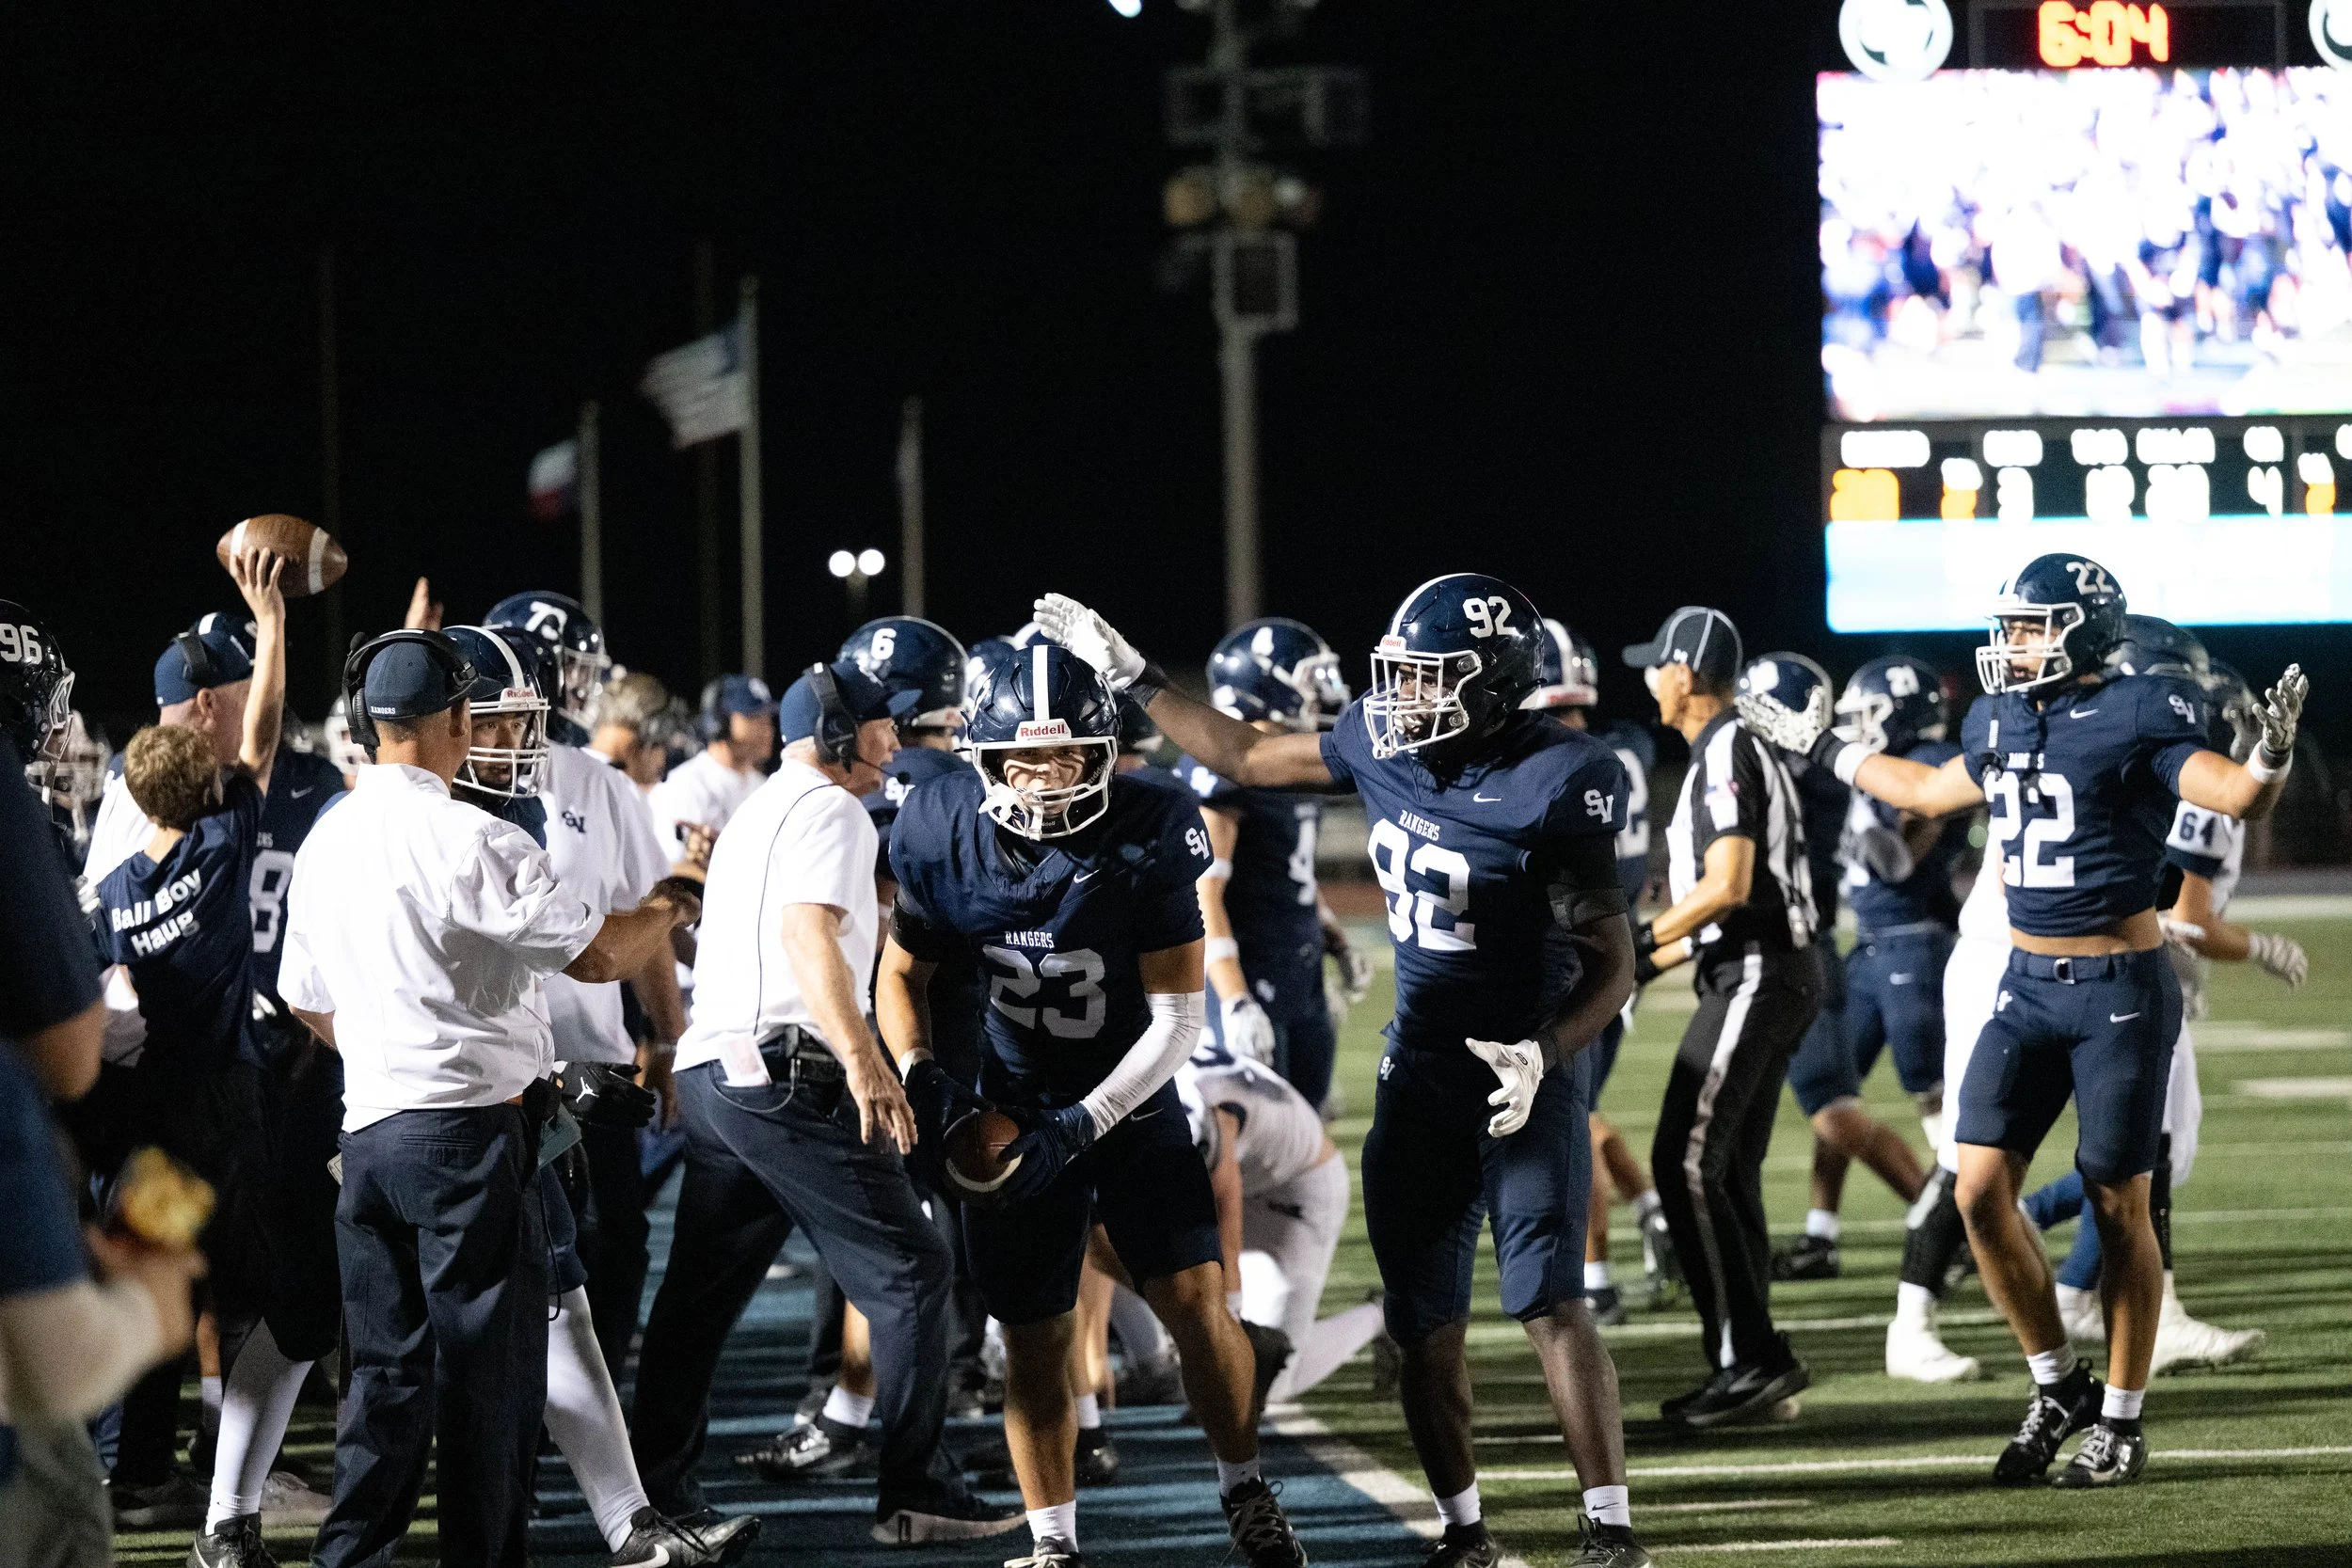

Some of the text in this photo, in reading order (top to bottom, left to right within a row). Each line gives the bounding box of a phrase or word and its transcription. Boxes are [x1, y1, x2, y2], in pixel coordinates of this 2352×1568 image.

[2039, 0, 2169, 67] 6:04
[2066, 562, 2115, 595] 22
[1463, 595, 1518, 639] 92
[0, 623, 42, 665] 96
[871, 628, 897, 660] 6
[370, 705, 396, 715] RANGERS
[1020, 723, 1066, 737] Riddell
[1583, 788, 1614, 824] SV
[1185, 827, 1210, 860] SV
[1398, 809, 1440, 842] RANGERS
[1983, 771, 2075, 888] 22
[2179, 812, 2217, 847] 64
[111, 867, 202, 933] Ball Boy
[1367, 818, 1477, 951] 92
[131, 910, 201, 957] Haug
[1005, 930, 1055, 949] RANGERS
[982, 943, 1106, 1039] 23
